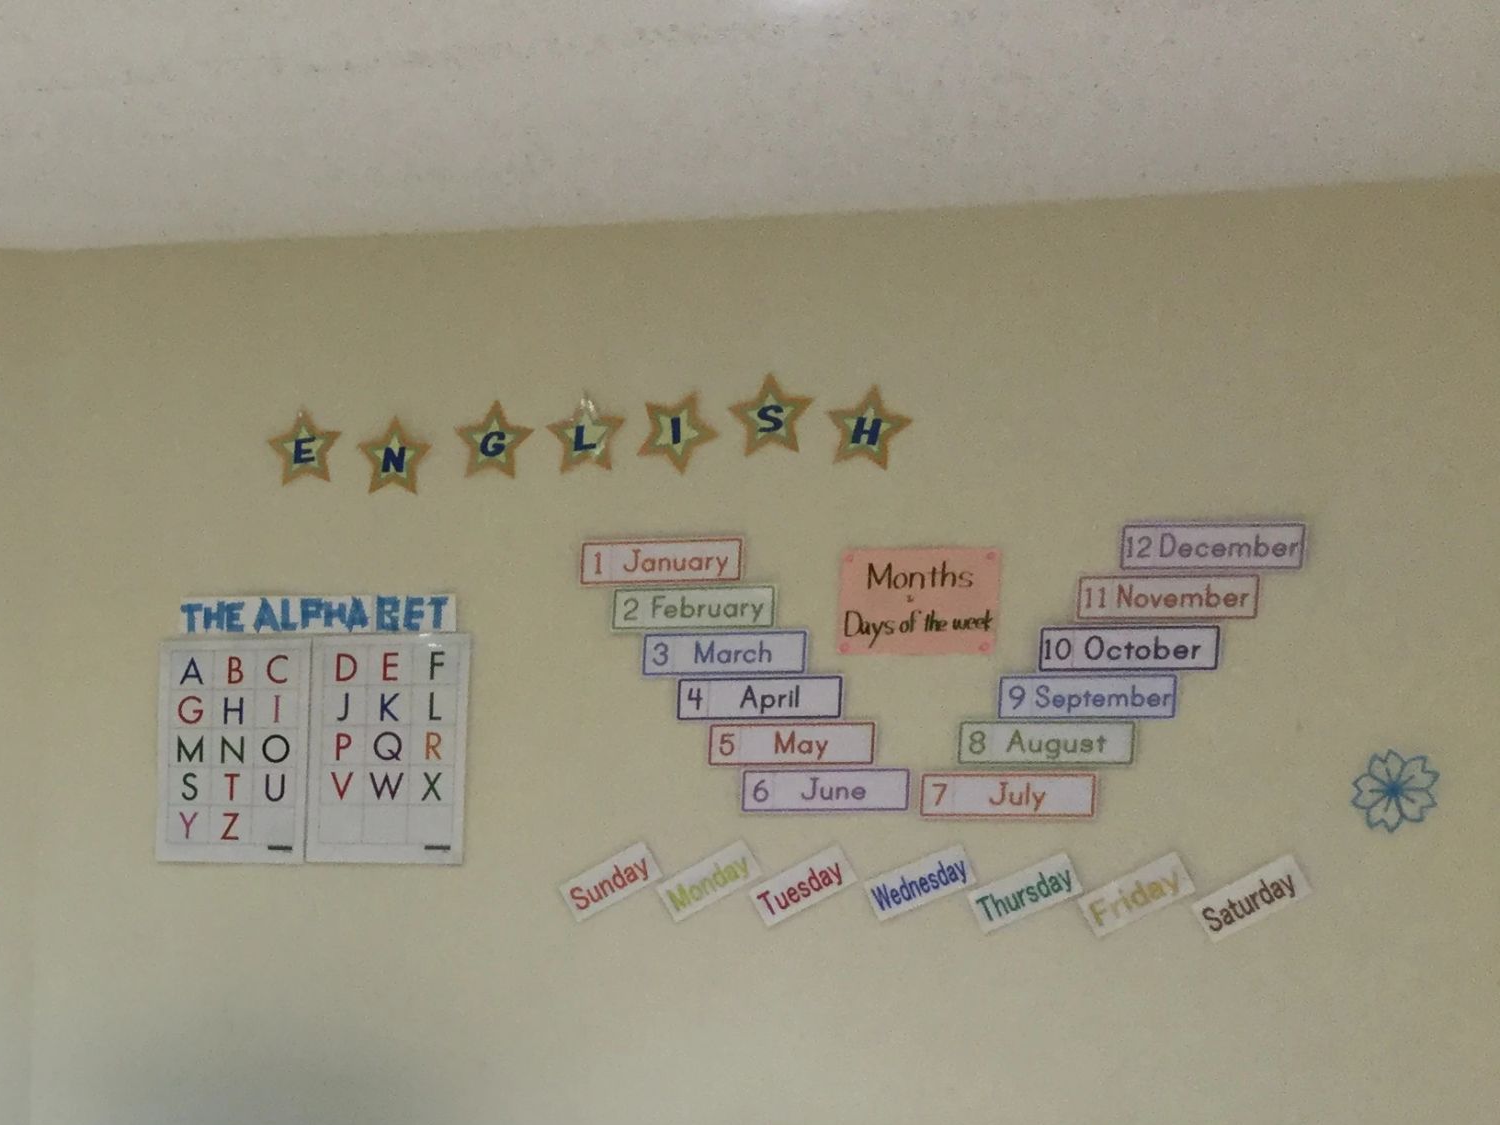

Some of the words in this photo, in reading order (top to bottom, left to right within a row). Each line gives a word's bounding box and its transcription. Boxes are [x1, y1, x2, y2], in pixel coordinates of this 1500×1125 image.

[294, 405, 881, 473] ENGLISH
[1126, 536, 1152, 559] 12
[1160, 533, 1299, 558] December
[594, 552, 602, 574] 1
[623, 549, 729, 575] January
[867, 561, 973, 590] Months
[623, 598, 639, 620] 2
[651, 596, 764, 622] February
[1085, 587, 1106, 609] 11
[1117, 584, 1249, 608] November
[180, 601, 245, 633] THE
[253, 594, 449, 633] ALPHABET
[844, 610, 895, 649] Days
[900, 609, 922, 633] of
[924, 610, 947, 632] the
[952, 609, 993, 631] week
[652, 642, 669, 666] 3
[694, 641, 772, 664] March
[1044, 638, 1072, 661] 10
[1085, 636, 1201, 661] October
[180, 658, 203, 684] A
[228, 656, 243, 684] B
[267, 655, 288, 683] C
[336, 654, 357, 681] D
[383, 652, 399, 681] E
[430, 652, 445, 680] F
[178, 696, 203, 724] G
[223, 697, 244, 724] H
[337, 693, 349, 721] J
[380, 693, 399, 721] K
[429, 692, 441, 721] L
[688, 688, 702, 710] 4
[740, 685, 800, 714] April
[1009, 686, 1025, 709] 9
[1035, 684, 1171, 712] September
[177, 736, 203, 762] M
[221, 736, 244, 763] N
[262, 734, 290, 763] O
[336, 733, 352, 760] P
[374, 731, 402, 761] Q
[425, 732, 442, 760] R
[719, 733, 735, 756] 5
[774, 731, 828, 759] May
[969, 731, 986, 754] 8
[1006, 730, 1107, 759] August
[181, 773, 197, 800] S
[224, 773, 240, 800] T
[265, 774, 285, 801] U
[331, 772, 353, 800] V
[370, 773, 404, 800] W
[422, 773, 442, 800] X
[753, 779, 769, 802] 6
[801, 778, 867, 801] June
[932, 784, 947, 805] 7
[989, 782, 1046, 812] July
[180, 812, 198, 839] Y
[221, 813, 239, 840] Z
[570, 857, 649, 910] Sunday
[666, 856, 749, 912] Monday
[756, 861, 844, 915] Tuesday
[870, 858, 967, 912] Wednesday
[976, 867, 1073, 921] Thursday
[1088, 871, 1181, 926] Friday
[1202, 873, 1296, 932] Saturday
